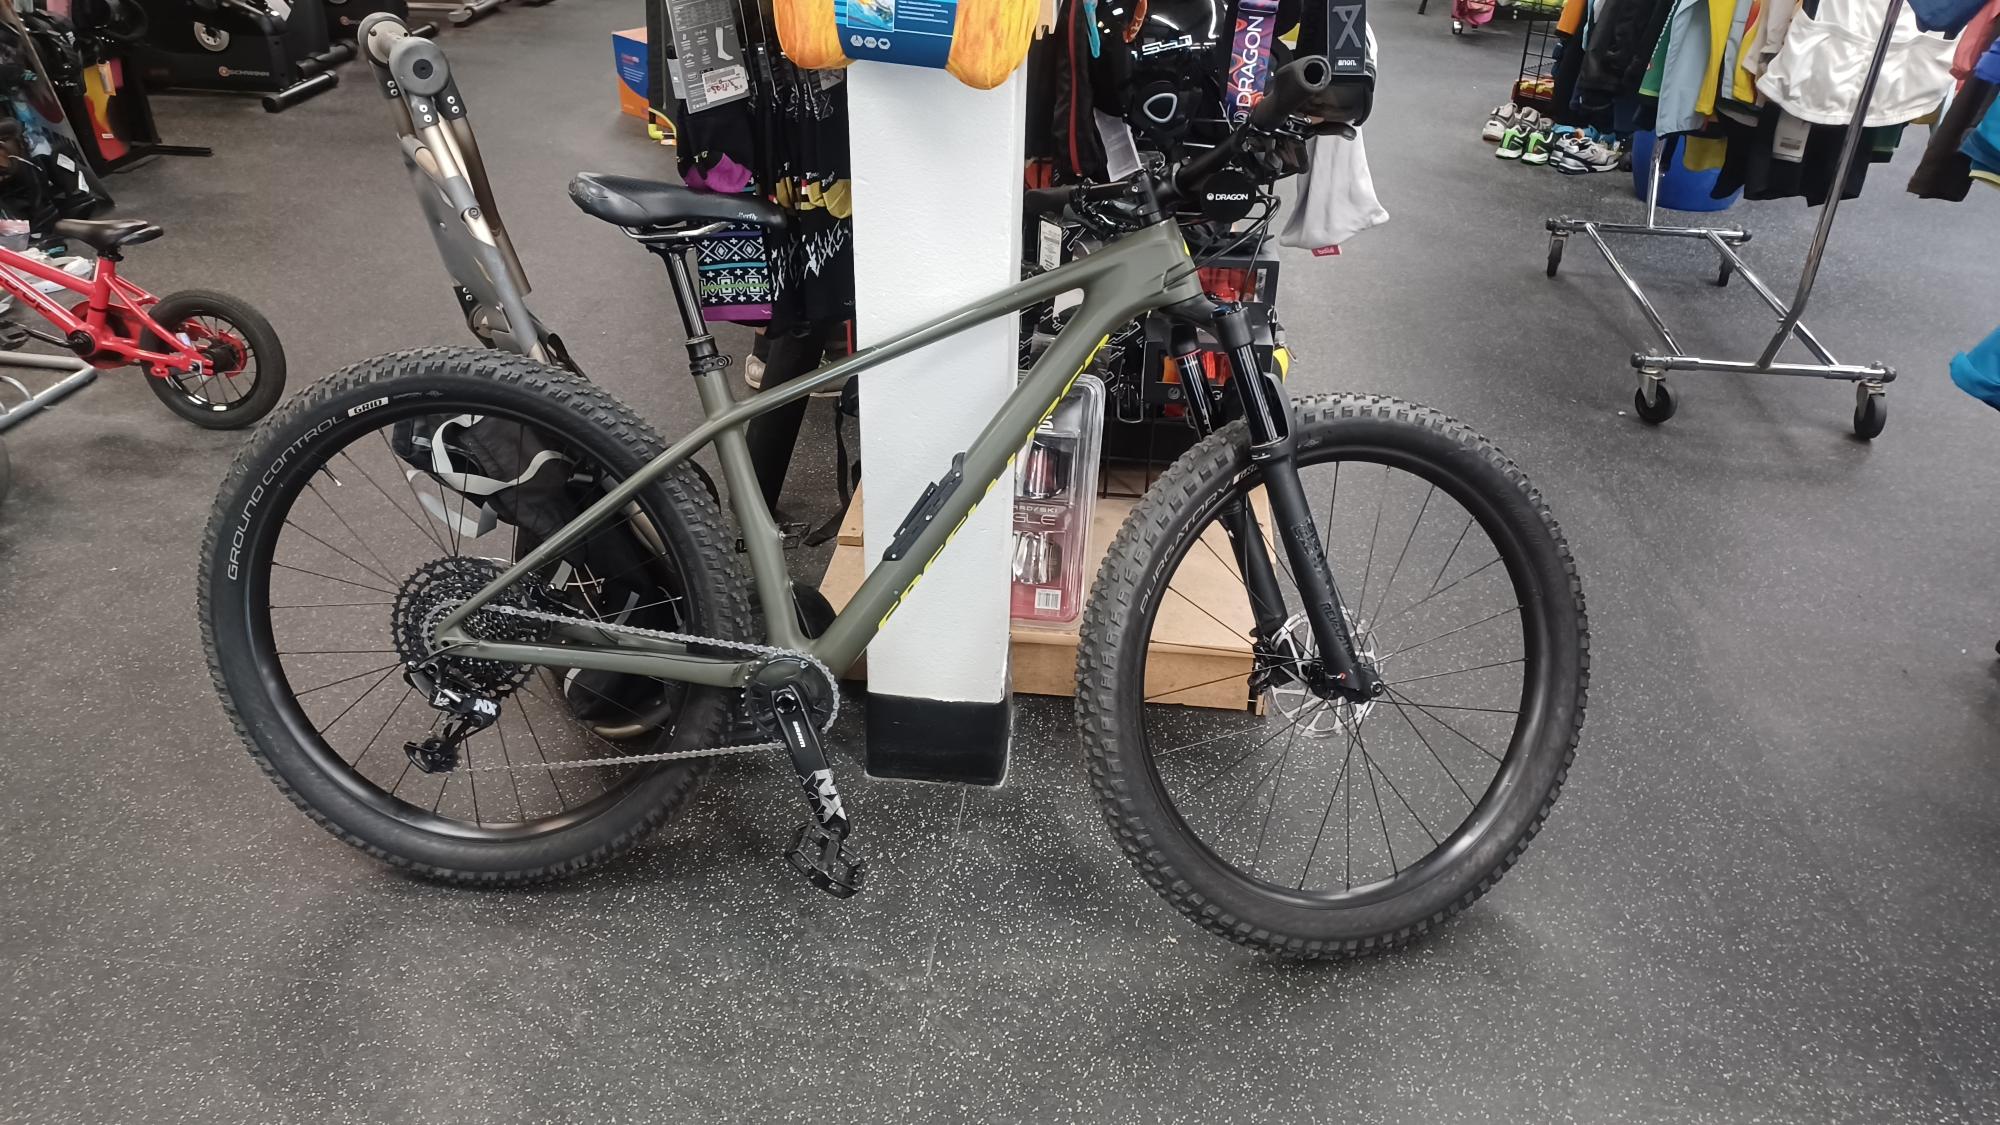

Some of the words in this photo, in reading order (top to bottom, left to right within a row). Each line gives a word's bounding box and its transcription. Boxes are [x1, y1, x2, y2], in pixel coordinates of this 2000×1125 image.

[1236, 15, 1265, 107] DRAGON
[1215, 193, 1249, 201] DRAGON
[353, 399, 382, 414] GRID
[227, 484, 265, 581] GROUND
[261, 416, 346, 488] CONTROL
[1140, 480, 1231, 614] PURGATORY
